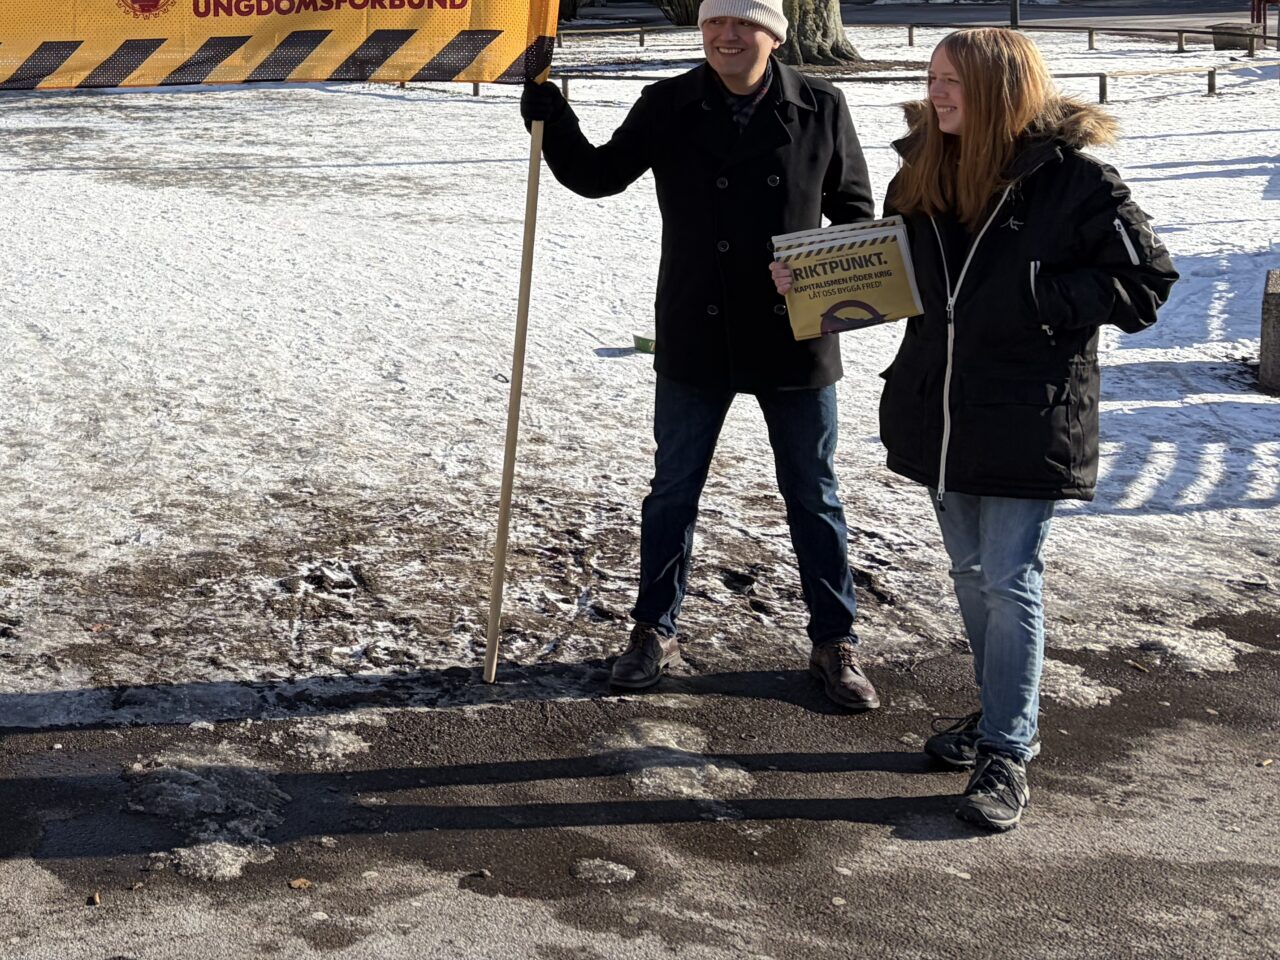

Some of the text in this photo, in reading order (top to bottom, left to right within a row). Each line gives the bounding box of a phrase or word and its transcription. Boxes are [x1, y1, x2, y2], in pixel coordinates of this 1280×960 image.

[792, 252, 888, 282] RIKTPUNKT.
[794, 269, 893, 294] KAPITALISMEN FÖDER KRIG
[808, 290, 821, 300] LÅT
[822, 288, 837, 297] OSS
[837, 284, 860, 294] BYGGA
